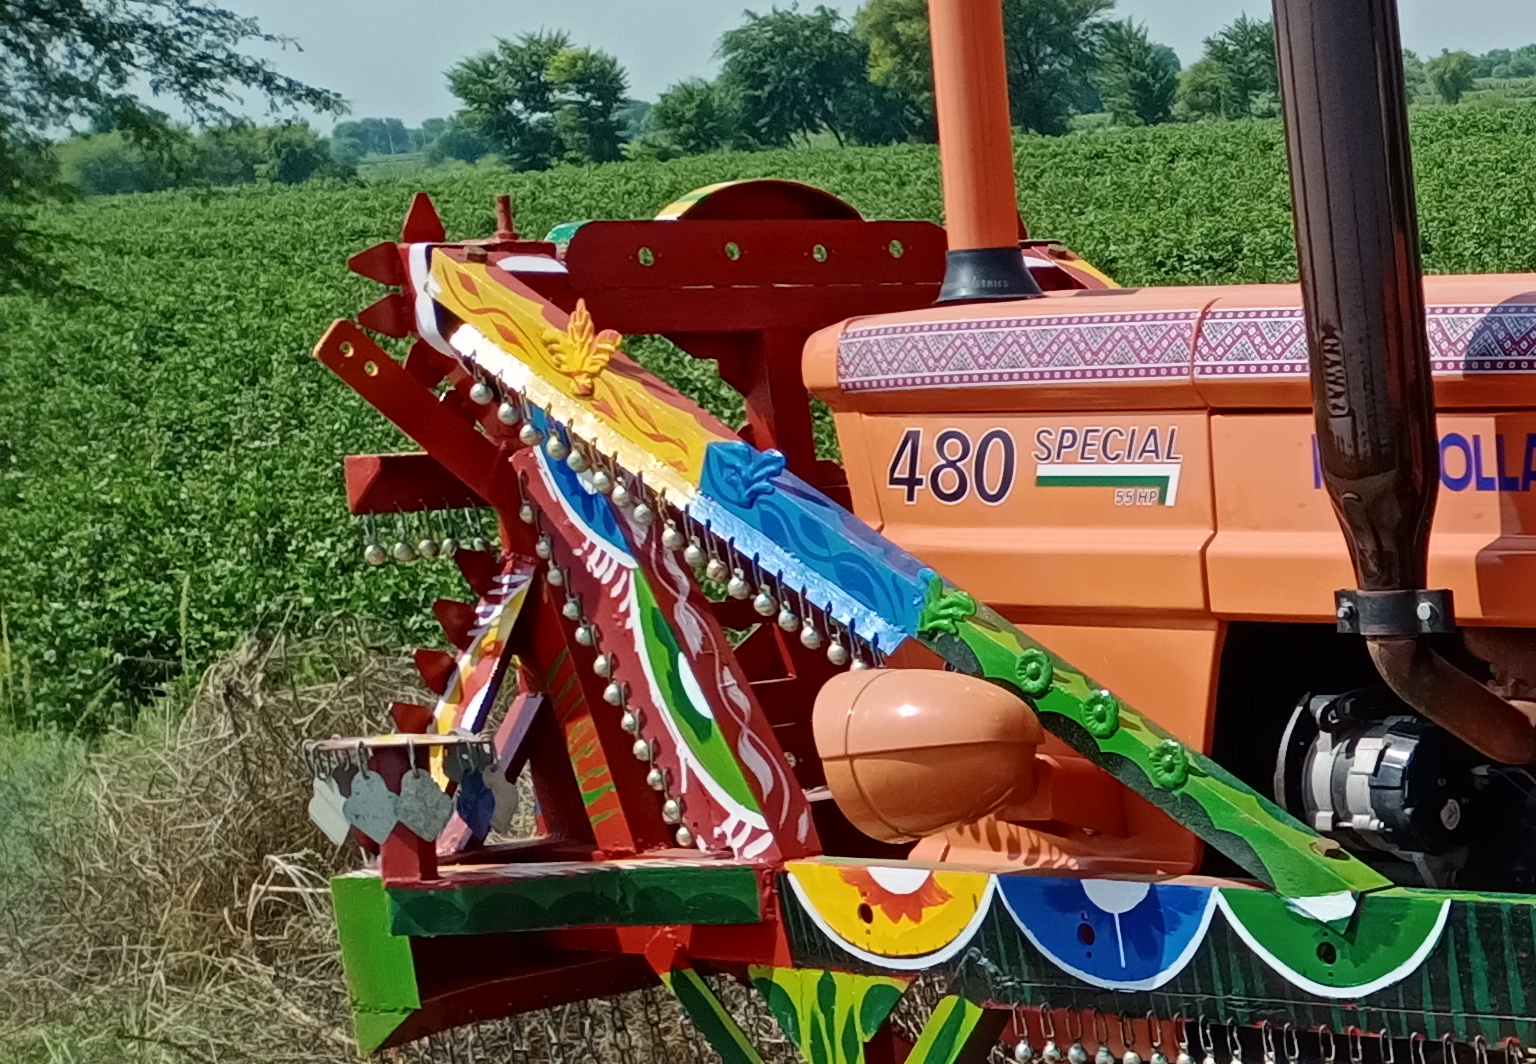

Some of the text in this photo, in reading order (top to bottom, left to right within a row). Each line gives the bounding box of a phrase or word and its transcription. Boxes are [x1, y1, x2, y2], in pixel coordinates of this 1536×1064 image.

[1034, 428, 1181, 462] SPECIAL
[888, 429, 1014, 504] 480
[1115, 490, 1158, 504] 55 HP
